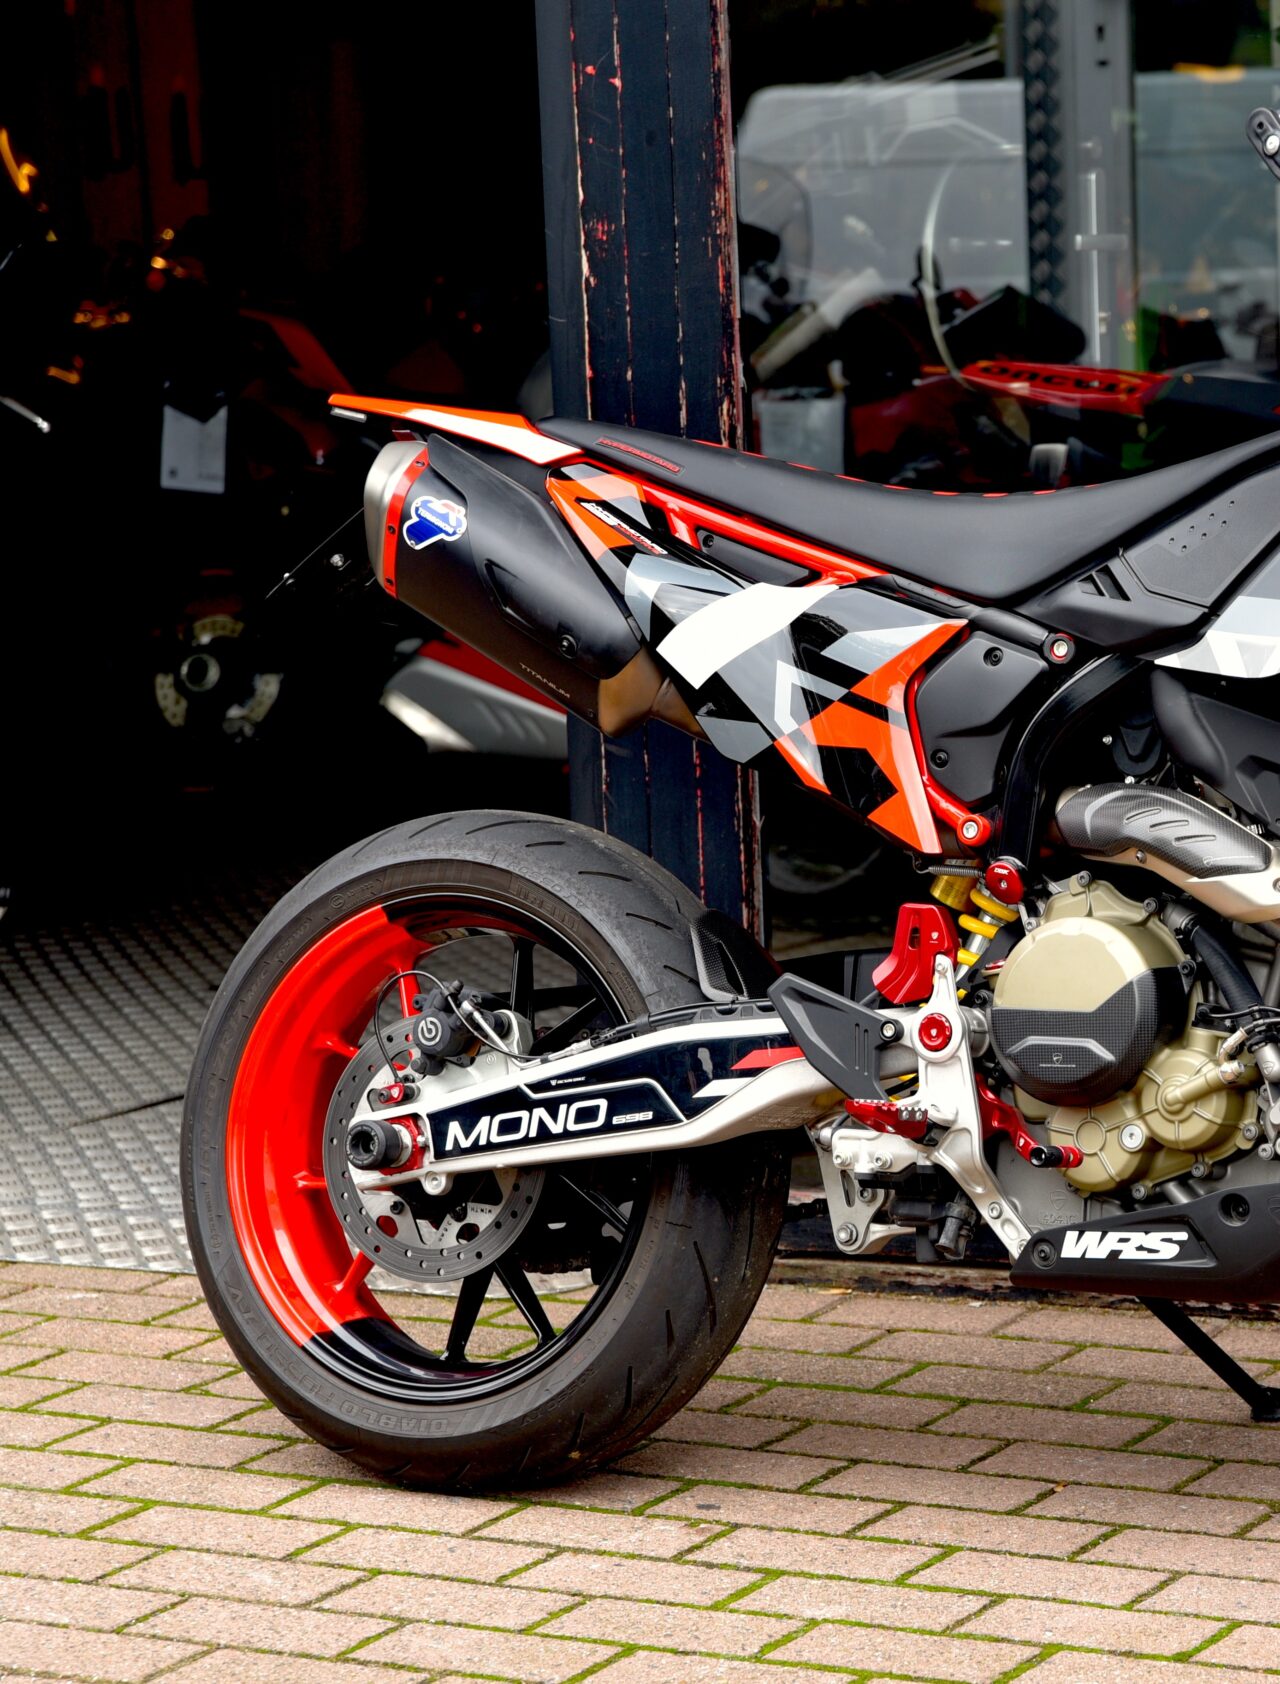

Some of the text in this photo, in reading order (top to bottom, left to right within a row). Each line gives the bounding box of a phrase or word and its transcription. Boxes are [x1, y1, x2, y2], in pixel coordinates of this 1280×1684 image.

[519, 662, 571, 699] TITANIUM
[444, 1098, 653, 1151] MONO 698
[1060, 1230, 1189, 1260] WRS
[339, 1400, 449, 1433] DIABLO
